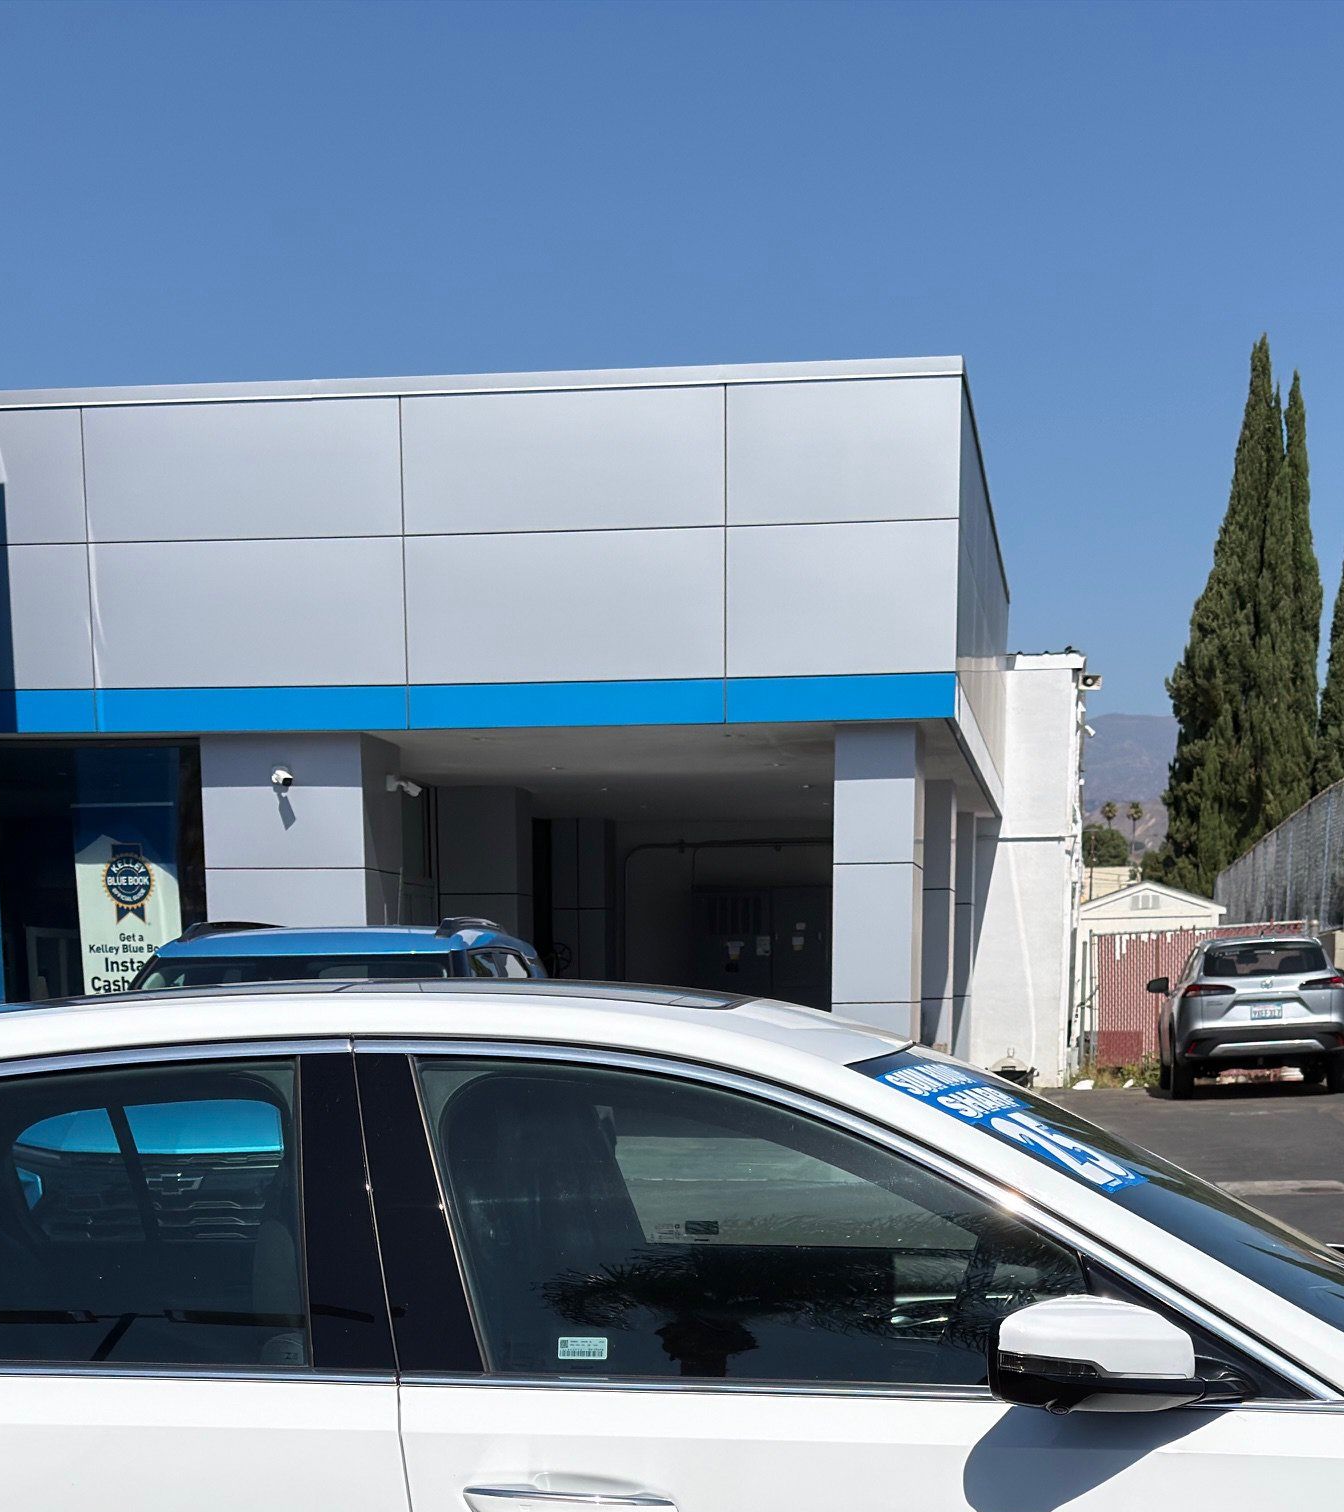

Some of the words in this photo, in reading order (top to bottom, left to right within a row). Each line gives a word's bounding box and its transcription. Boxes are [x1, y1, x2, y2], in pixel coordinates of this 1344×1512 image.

[110, 859, 146, 873] KELLEY
[107, 876, 127, 886] BLUE
[128, 876, 150, 886] BOOK
[119, 932, 136, 942] Get
[138, 934, 144, 942] a
[89, 944, 120, 955] Kelley
[122, 944, 144, 954] Blue
[884, 1068, 949, 1096] SUN
[936, 1086, 1021, 1119] SHARP
[990, 1112, 1136, 1186] 25
